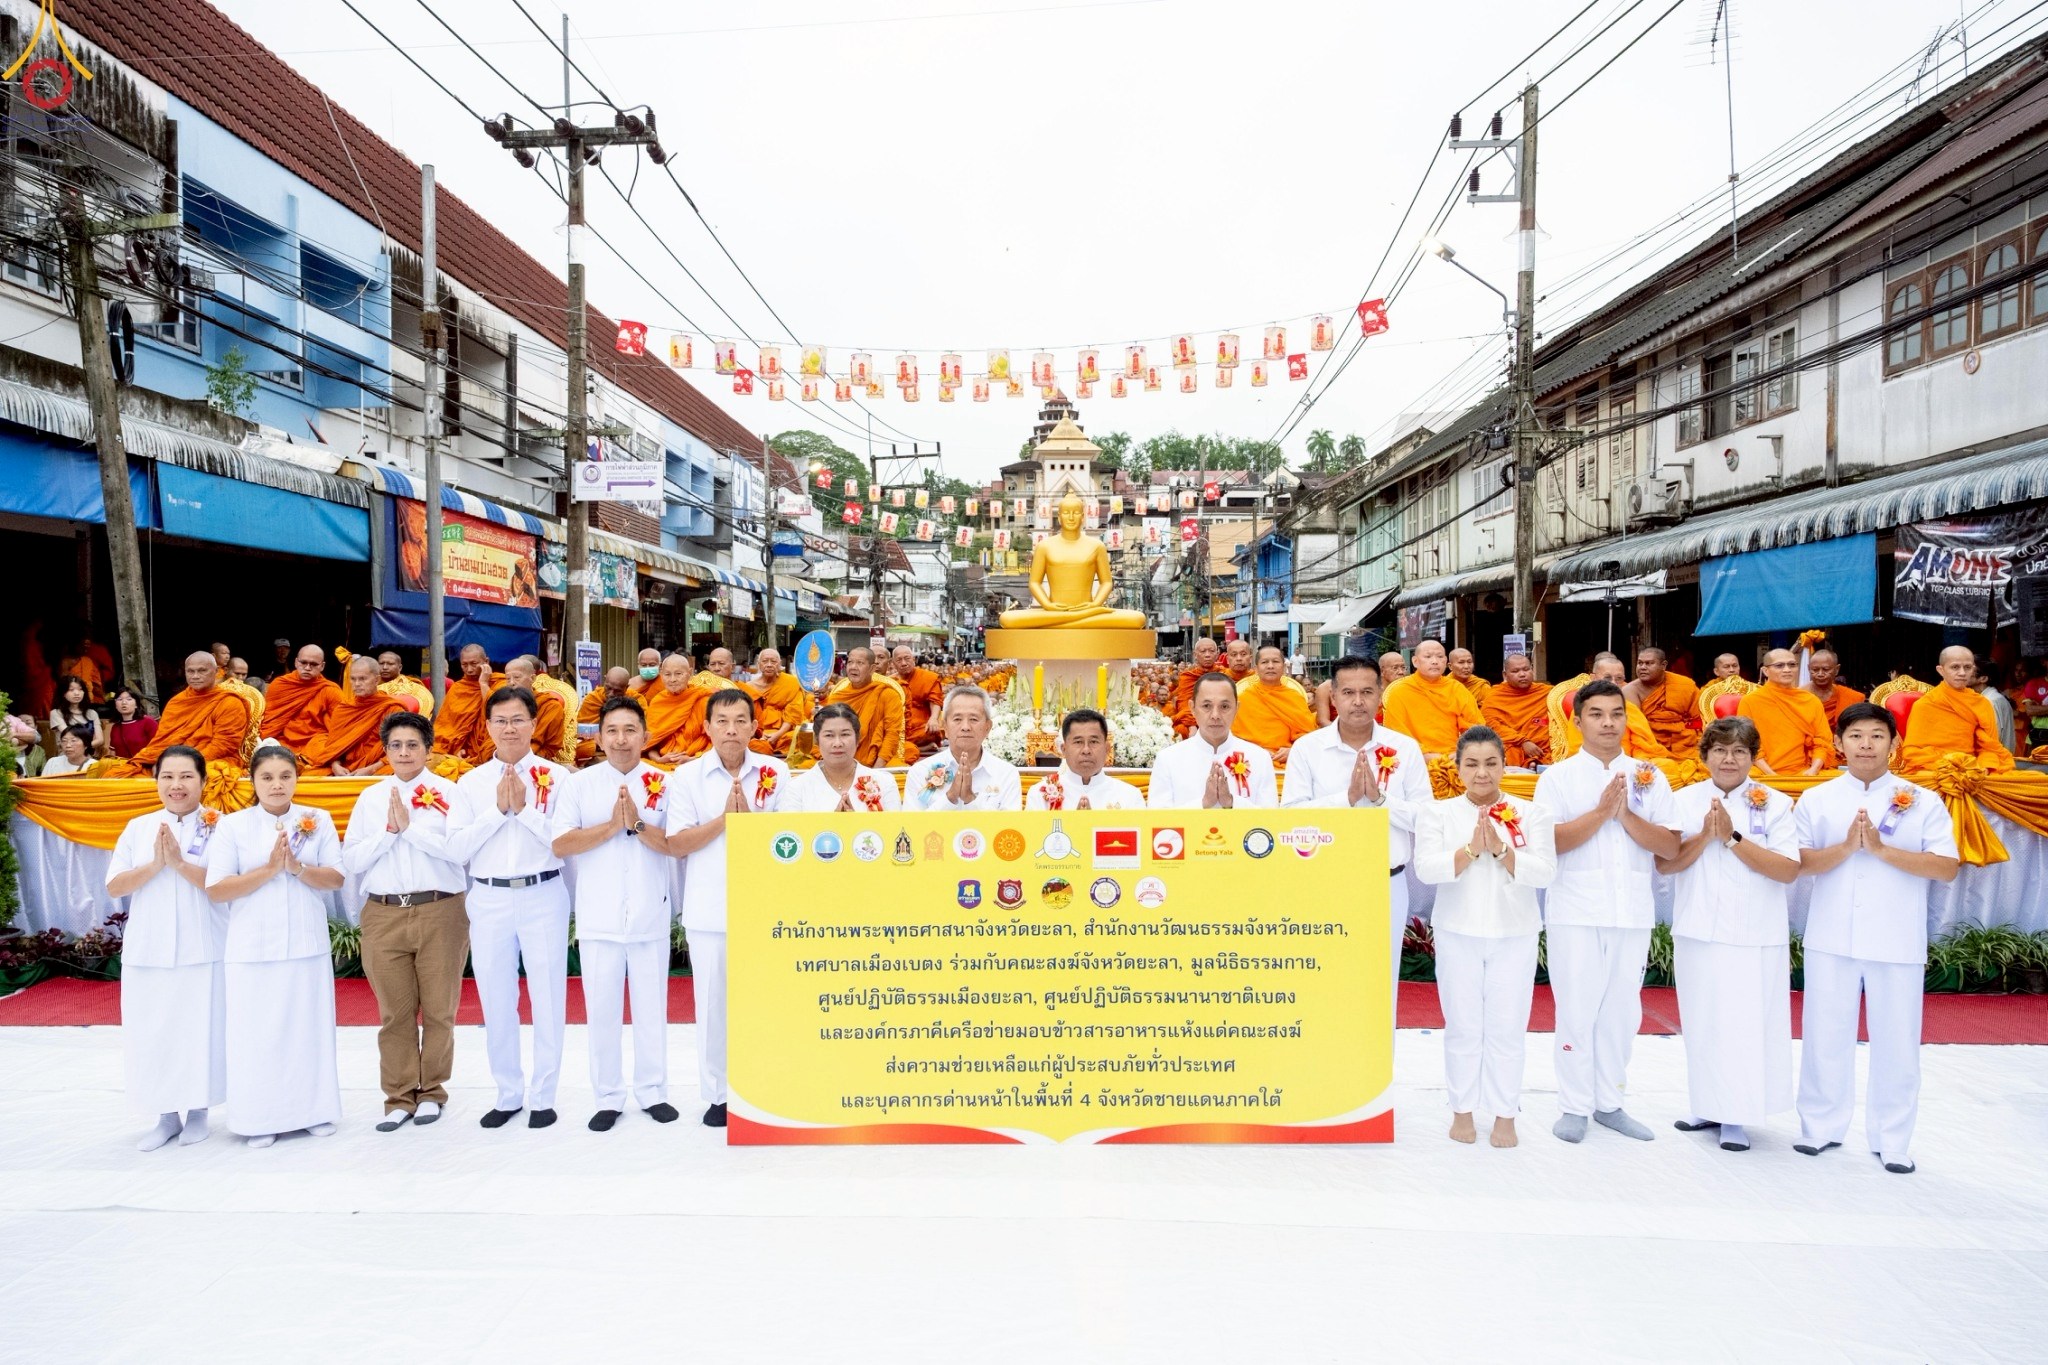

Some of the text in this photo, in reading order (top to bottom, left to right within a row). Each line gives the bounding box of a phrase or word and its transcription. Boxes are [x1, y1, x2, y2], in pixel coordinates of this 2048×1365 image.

[1895, 542, 2016, 592] AMONE
[1931, 584, 1943, 592] TOP
[1944, 585, 1964, 595] CLASS
[1280, 835, 1333, 844] THAILAND
[1195, 849, 1218, 857] Betong
[772, 918, 1348, 944] สำนักงานพระพุทธศาสนาจังหวัดยะลา, สำนักงานวัฒนธรรมจังหวัดยะลา,
[796, 952, 1321, 977] เทศบาลเมืองเบตง ร่วมกับคณะสงฆ์จังหวัดยะลา, มูลนิธิธรรมกาย,
[818, 986, 1296, 1013] ศูนย์ปฏิบัติธรรมเมืองยะลา, ศูนย์ปฏิบัติธรรมนานาชาติเบตง
[820, 1019, 1303, 1040] และองค์กรภาคีเครือข่ายมอบข้าวสารอาหารแห้งแด่คณะสงฆ์
[886, 1047, 1236, 1079] ส่งความช่วยเหลือแก่ผู้ประสบภัยทั่วประเทศ
[841, 1081, 1283, 1115] และบุคลากรด่านหน้าในพื้นที่ 4 จังหวัดชายแดนภาคใต้
